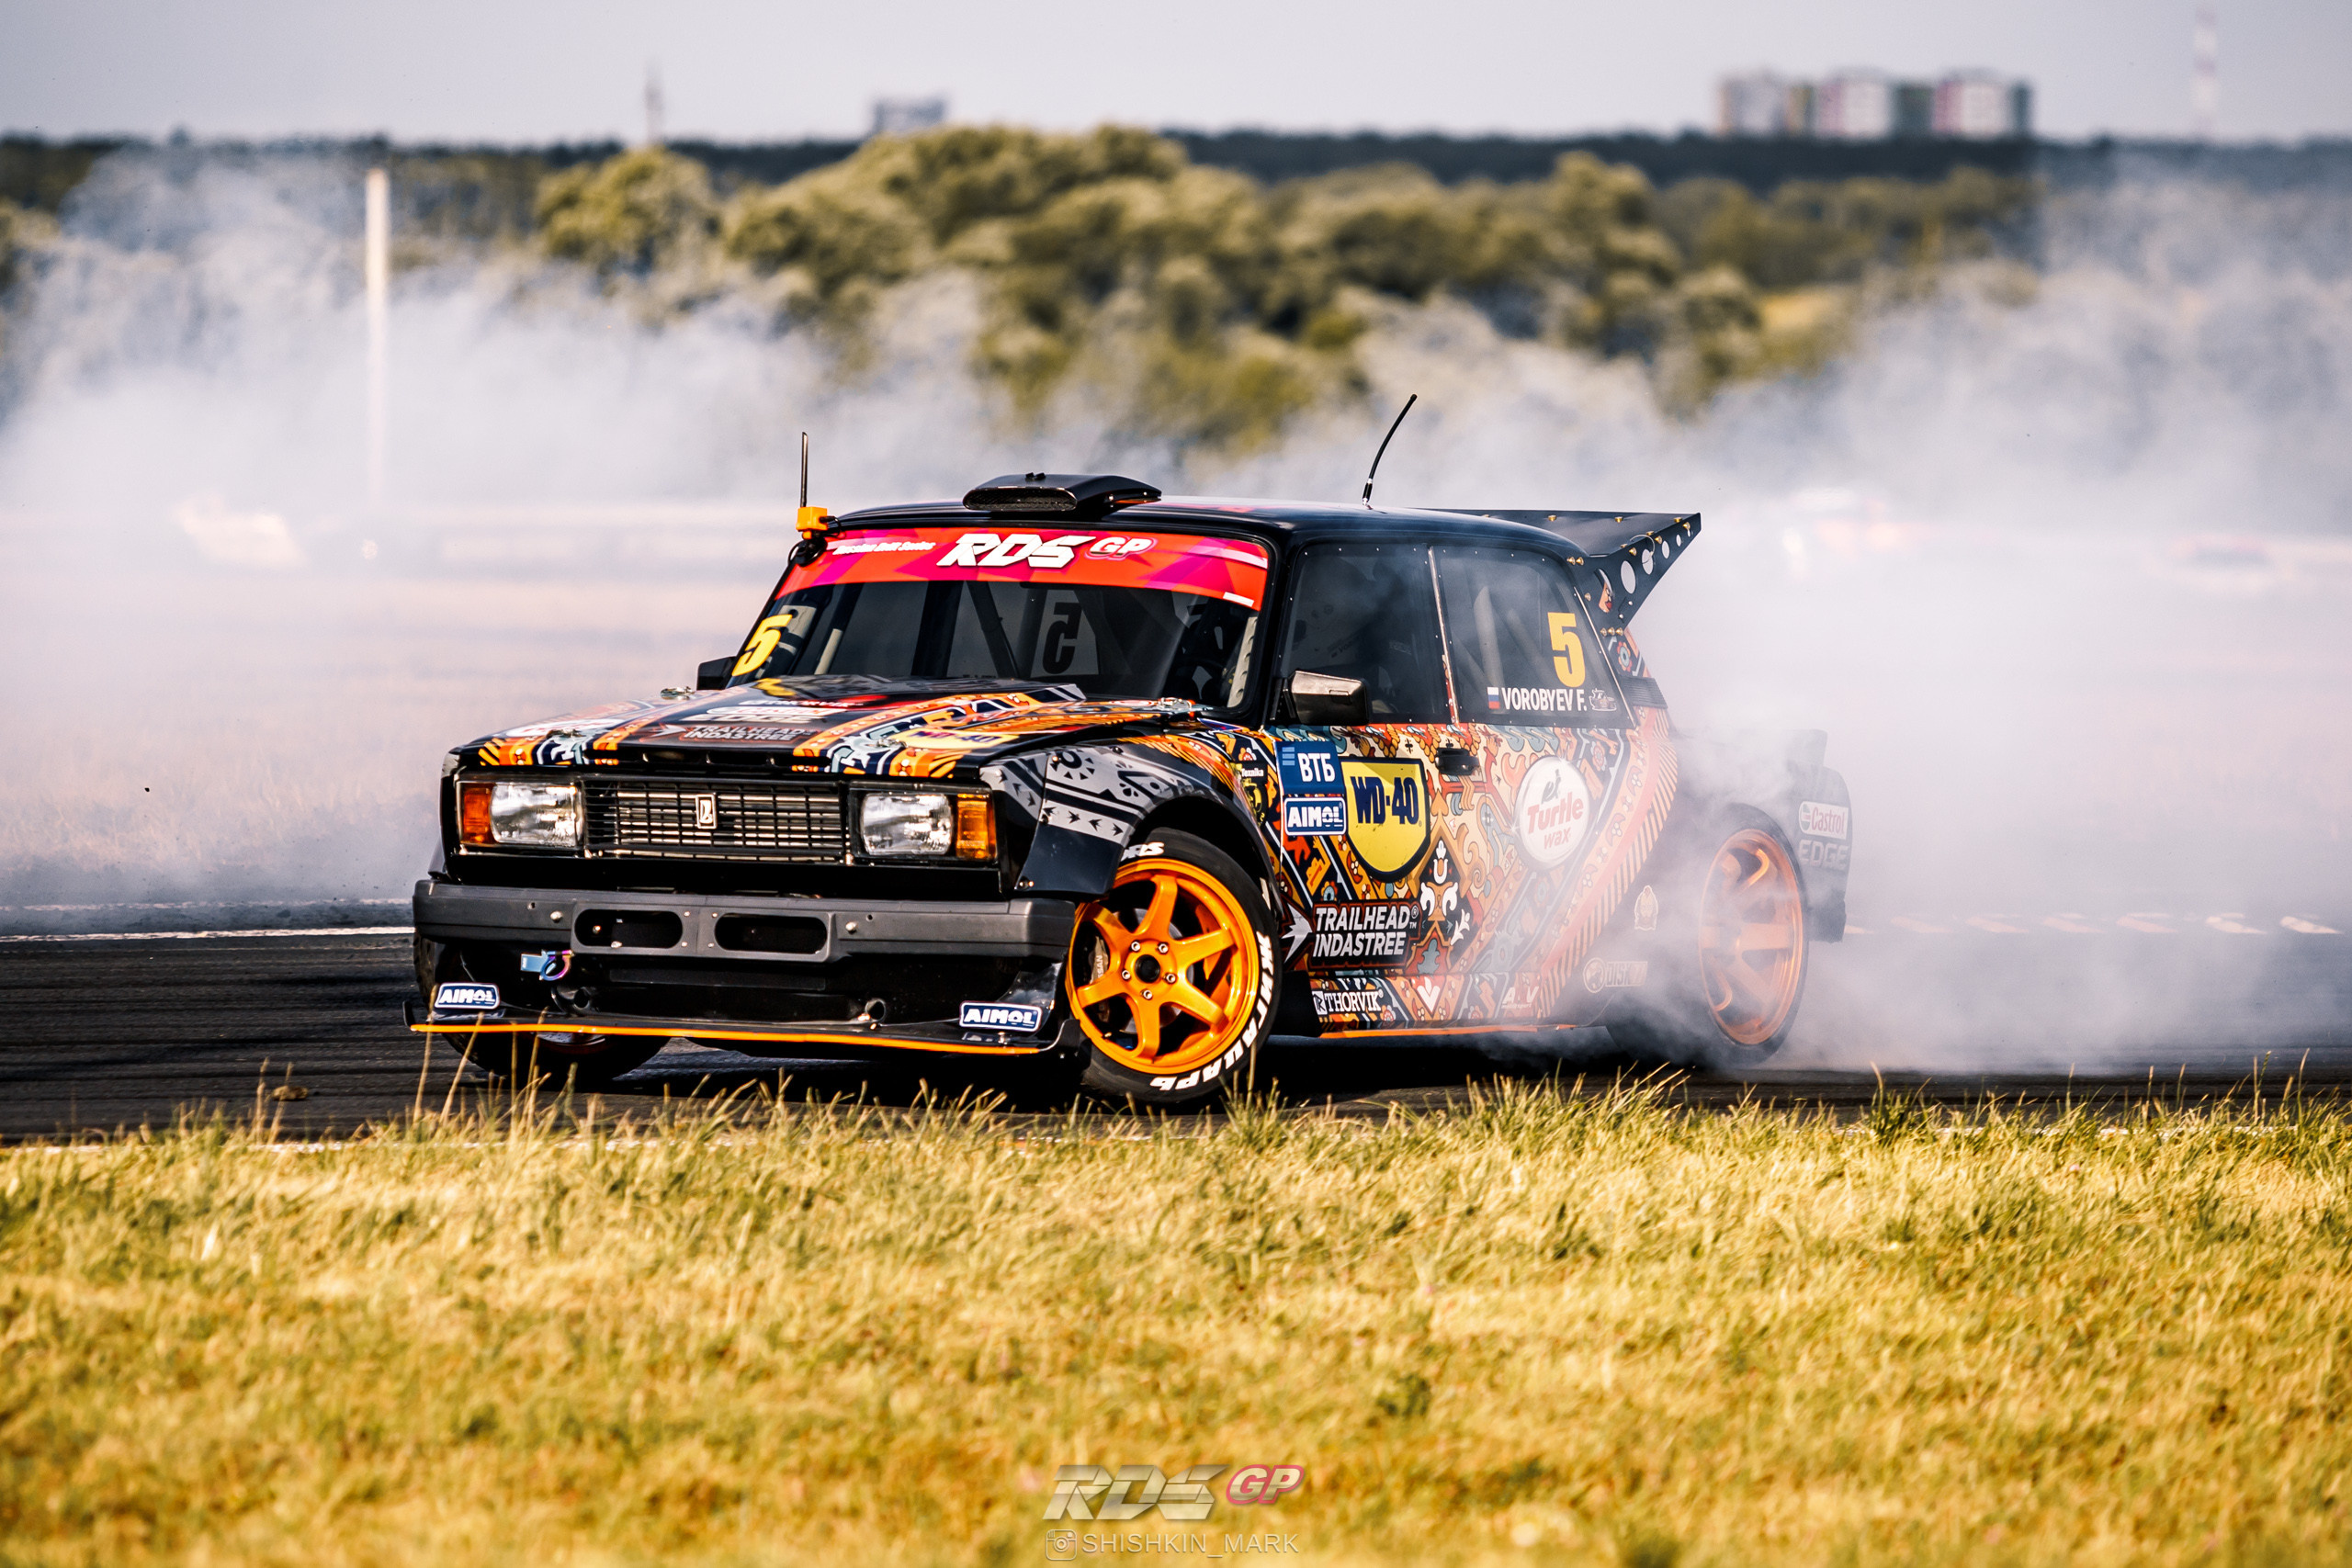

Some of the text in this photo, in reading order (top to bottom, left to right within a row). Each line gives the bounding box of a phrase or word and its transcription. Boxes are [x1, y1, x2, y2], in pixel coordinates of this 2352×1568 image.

[935, 533, 1155, 569] RDS GP
[731, 614, 793, 677] 5
[1547, 612, 1586, 688] 5
[1501, 687, 1588, 712] VOROBYEV F.
[684, 731, 797, 741] INDASTREE
[693, 725, 803, 736] TRAILHEAD
[1297, 752, 1336, 783] ВТБ
[1350, 775, 1419, 825] WD-40
[1526, 792, 1585, 834] Turtle
[1287, 806, 1344, 827] AIMOL
[1811, 807, 1846, 835] Castrol
[1798, 839, 1849, 871] EDGE
[1316, 906, 1410, 931] TRAILHEAD
[1313, 931, 1408, 957] INDASTREE
[438, 988, 496, 1005] AIMOL
[1324, 992, 1382, 1012] THORVIK
[964, 1009, 1035, 1027] AIMOL
